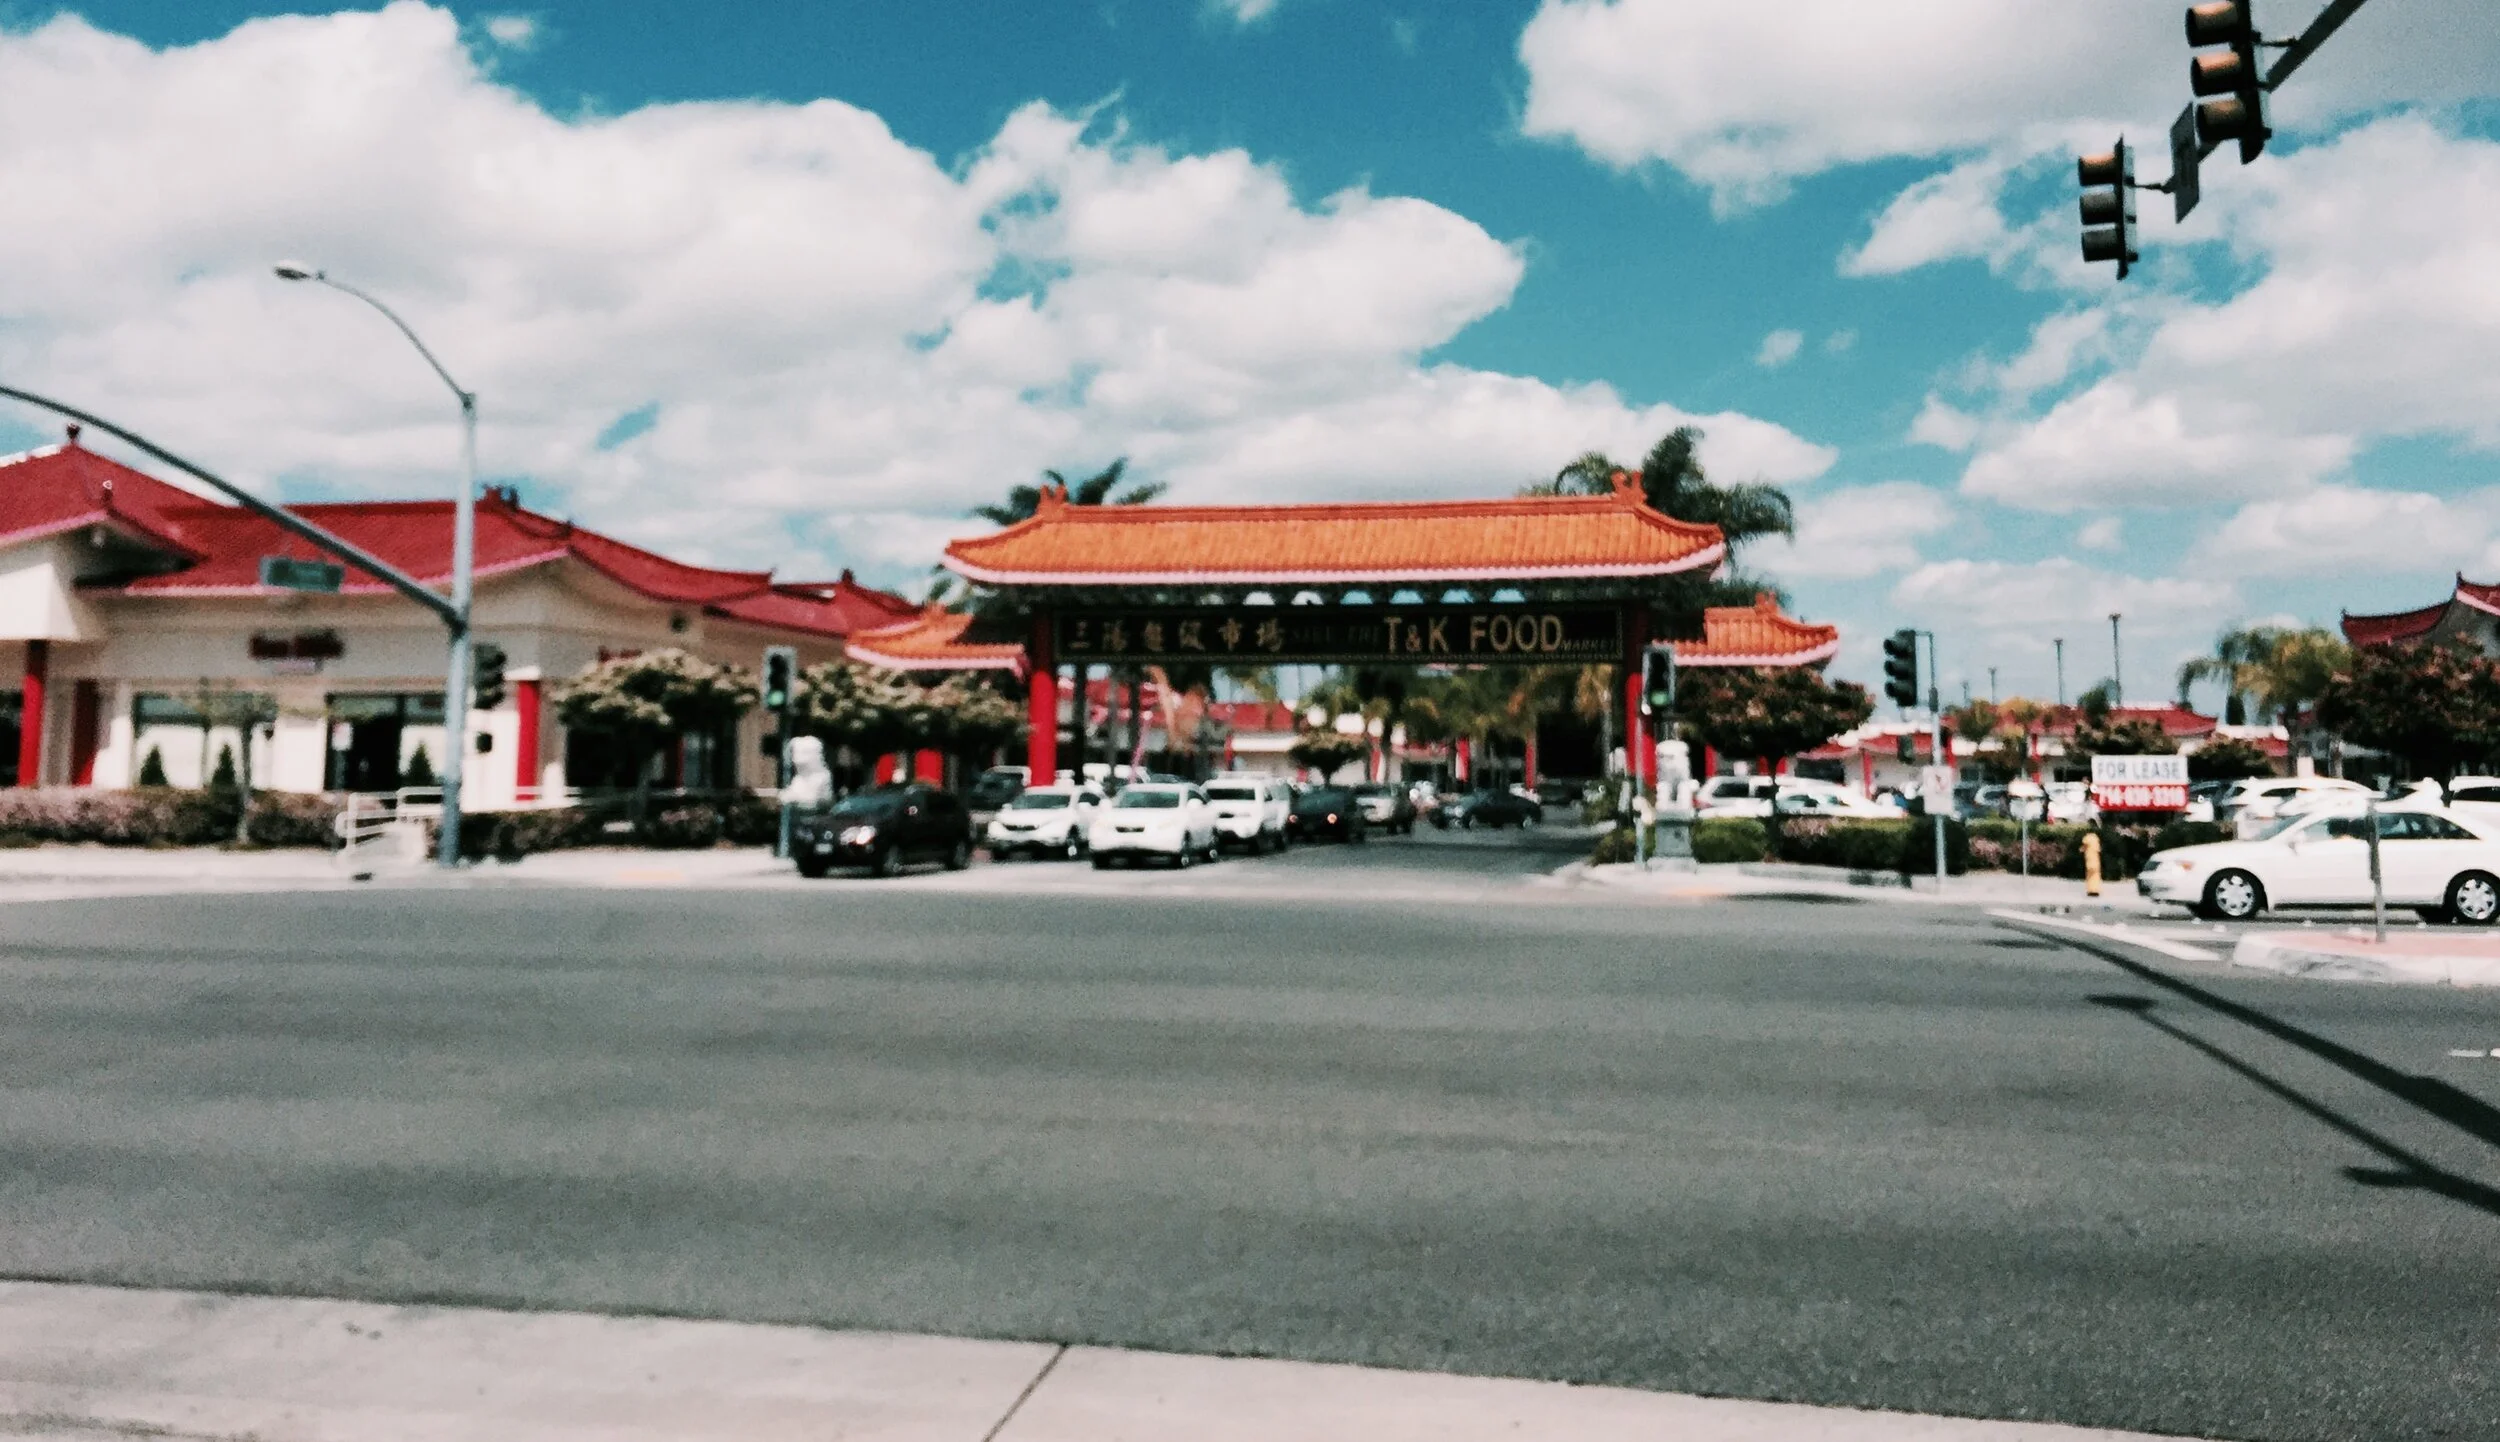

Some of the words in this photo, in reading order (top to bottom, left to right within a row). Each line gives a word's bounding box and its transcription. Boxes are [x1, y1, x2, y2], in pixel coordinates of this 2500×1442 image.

[1384, 616, 1450, 652] T&K
[1470, 614, 1562, 652] FOOD
[1561, 638, 1615, 652] MARKET
[2097, 762, 2126, 778] FOR
[2133, 762, 2180, 779] LEASE
